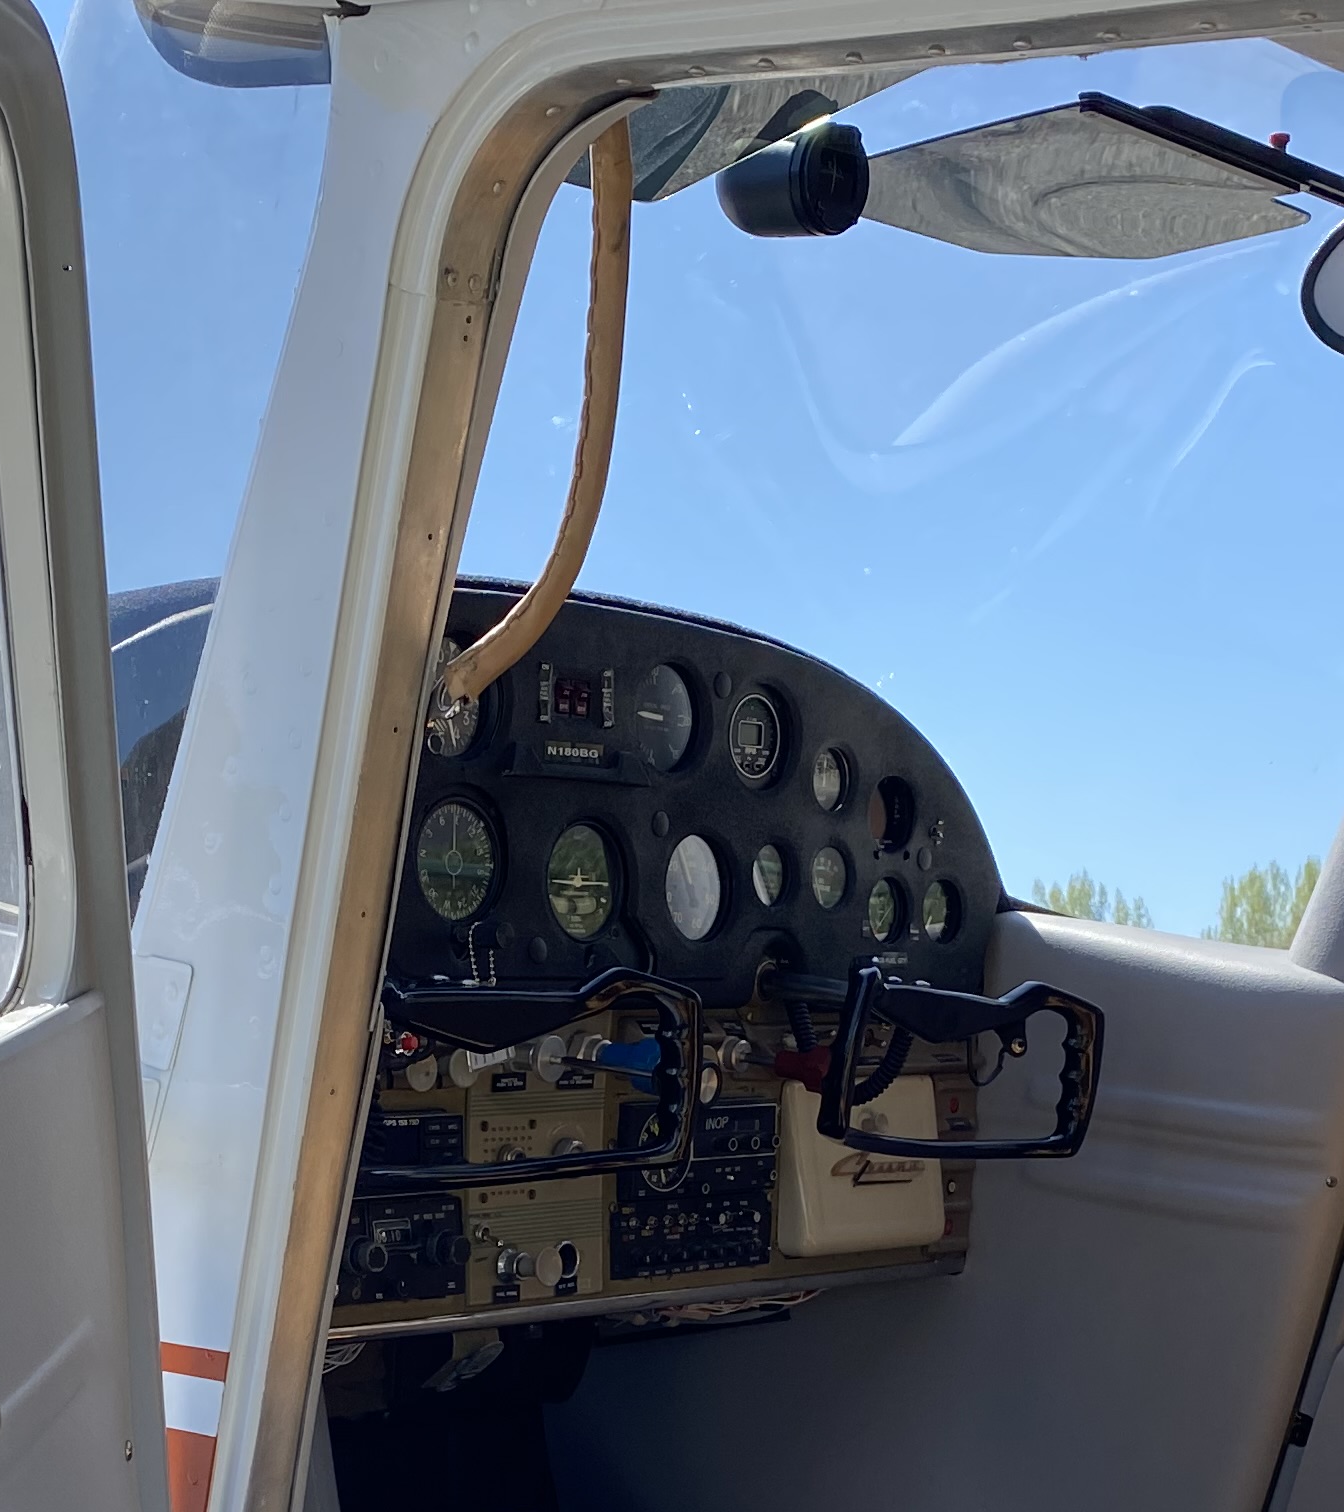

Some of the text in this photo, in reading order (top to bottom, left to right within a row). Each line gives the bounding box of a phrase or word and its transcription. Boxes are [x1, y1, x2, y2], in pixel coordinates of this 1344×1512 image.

[462, 711, 470, 726] 3
[547, 745, 599, 759] N180BG
[705, 1116, 729, 1131] INOP
